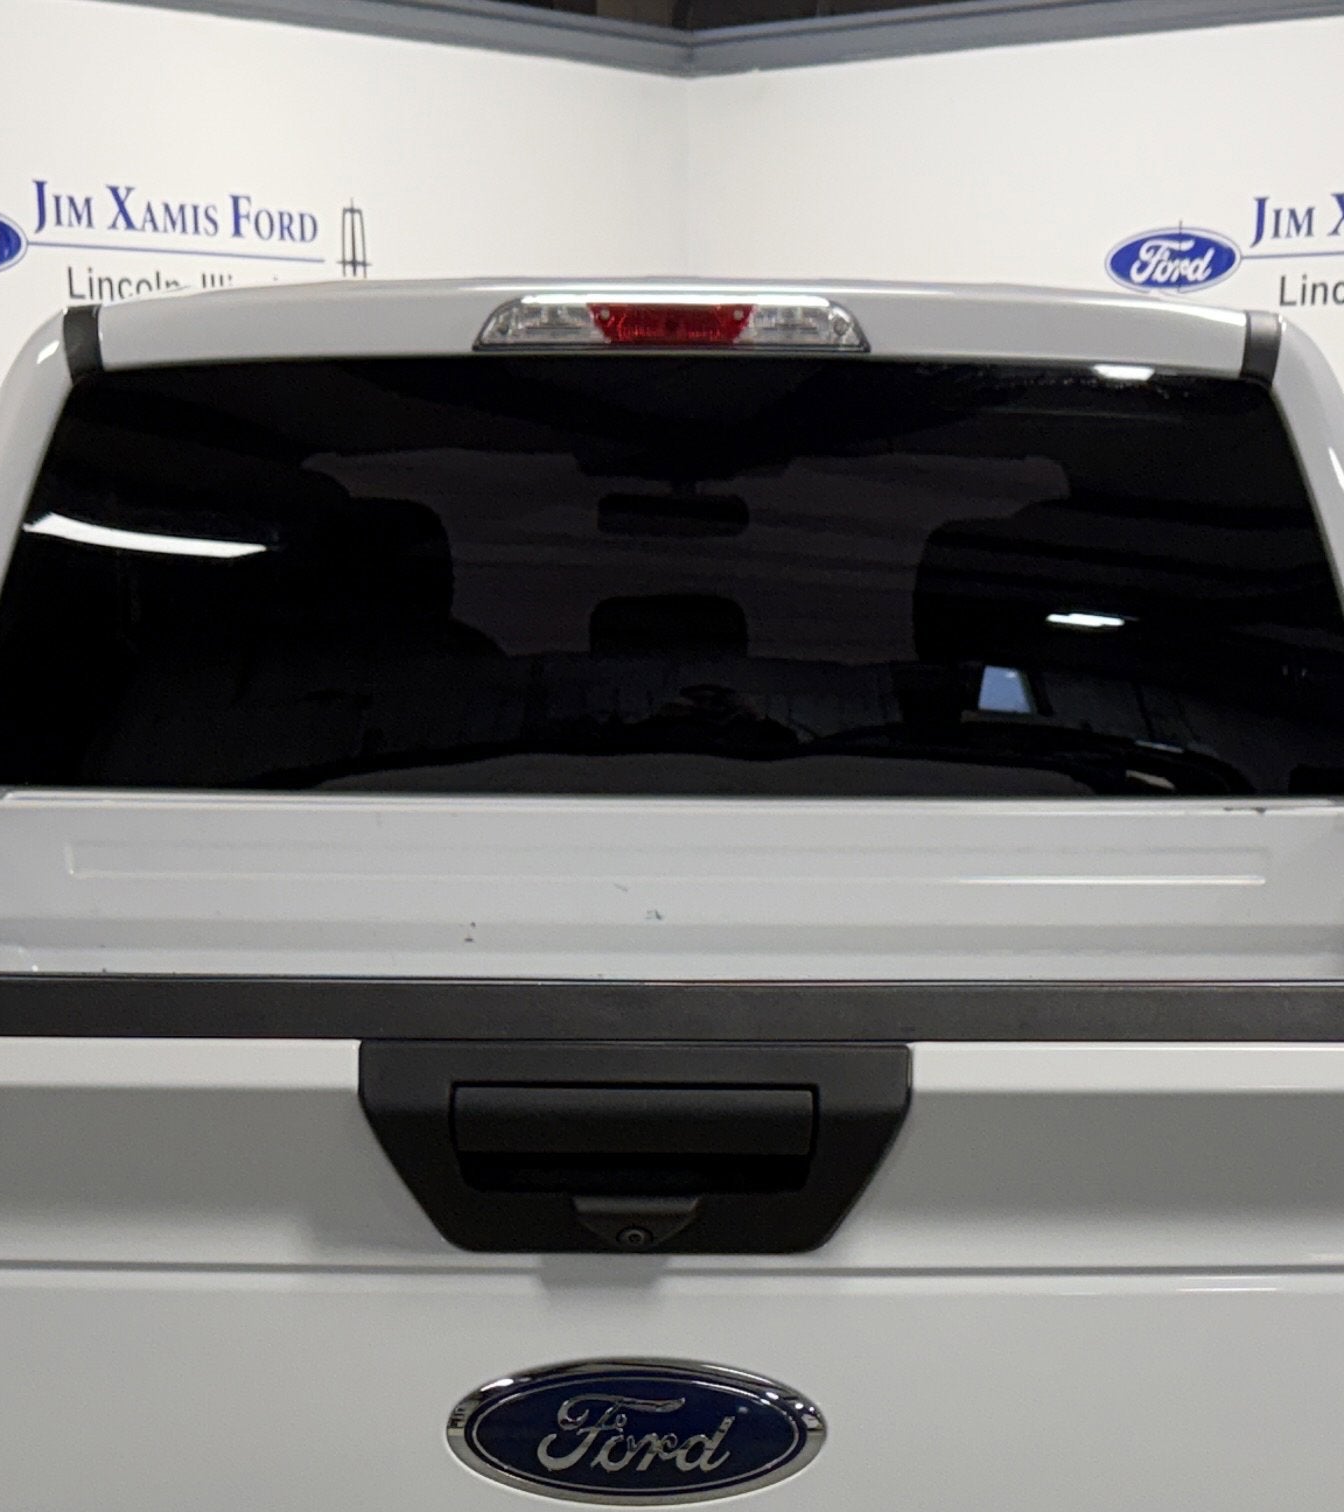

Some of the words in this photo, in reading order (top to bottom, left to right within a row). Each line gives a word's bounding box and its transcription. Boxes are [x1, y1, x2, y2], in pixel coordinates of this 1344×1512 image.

[32, 178, 95, 235] JIM
[106, 183, 219, 238] XAMIS
[229, 193, 318, 244] FORD
[1249, 195, 1316, 249] JIM
[1129, 238, 1213, 286] Ford
[535, 1392, 731, 1476] Ford
